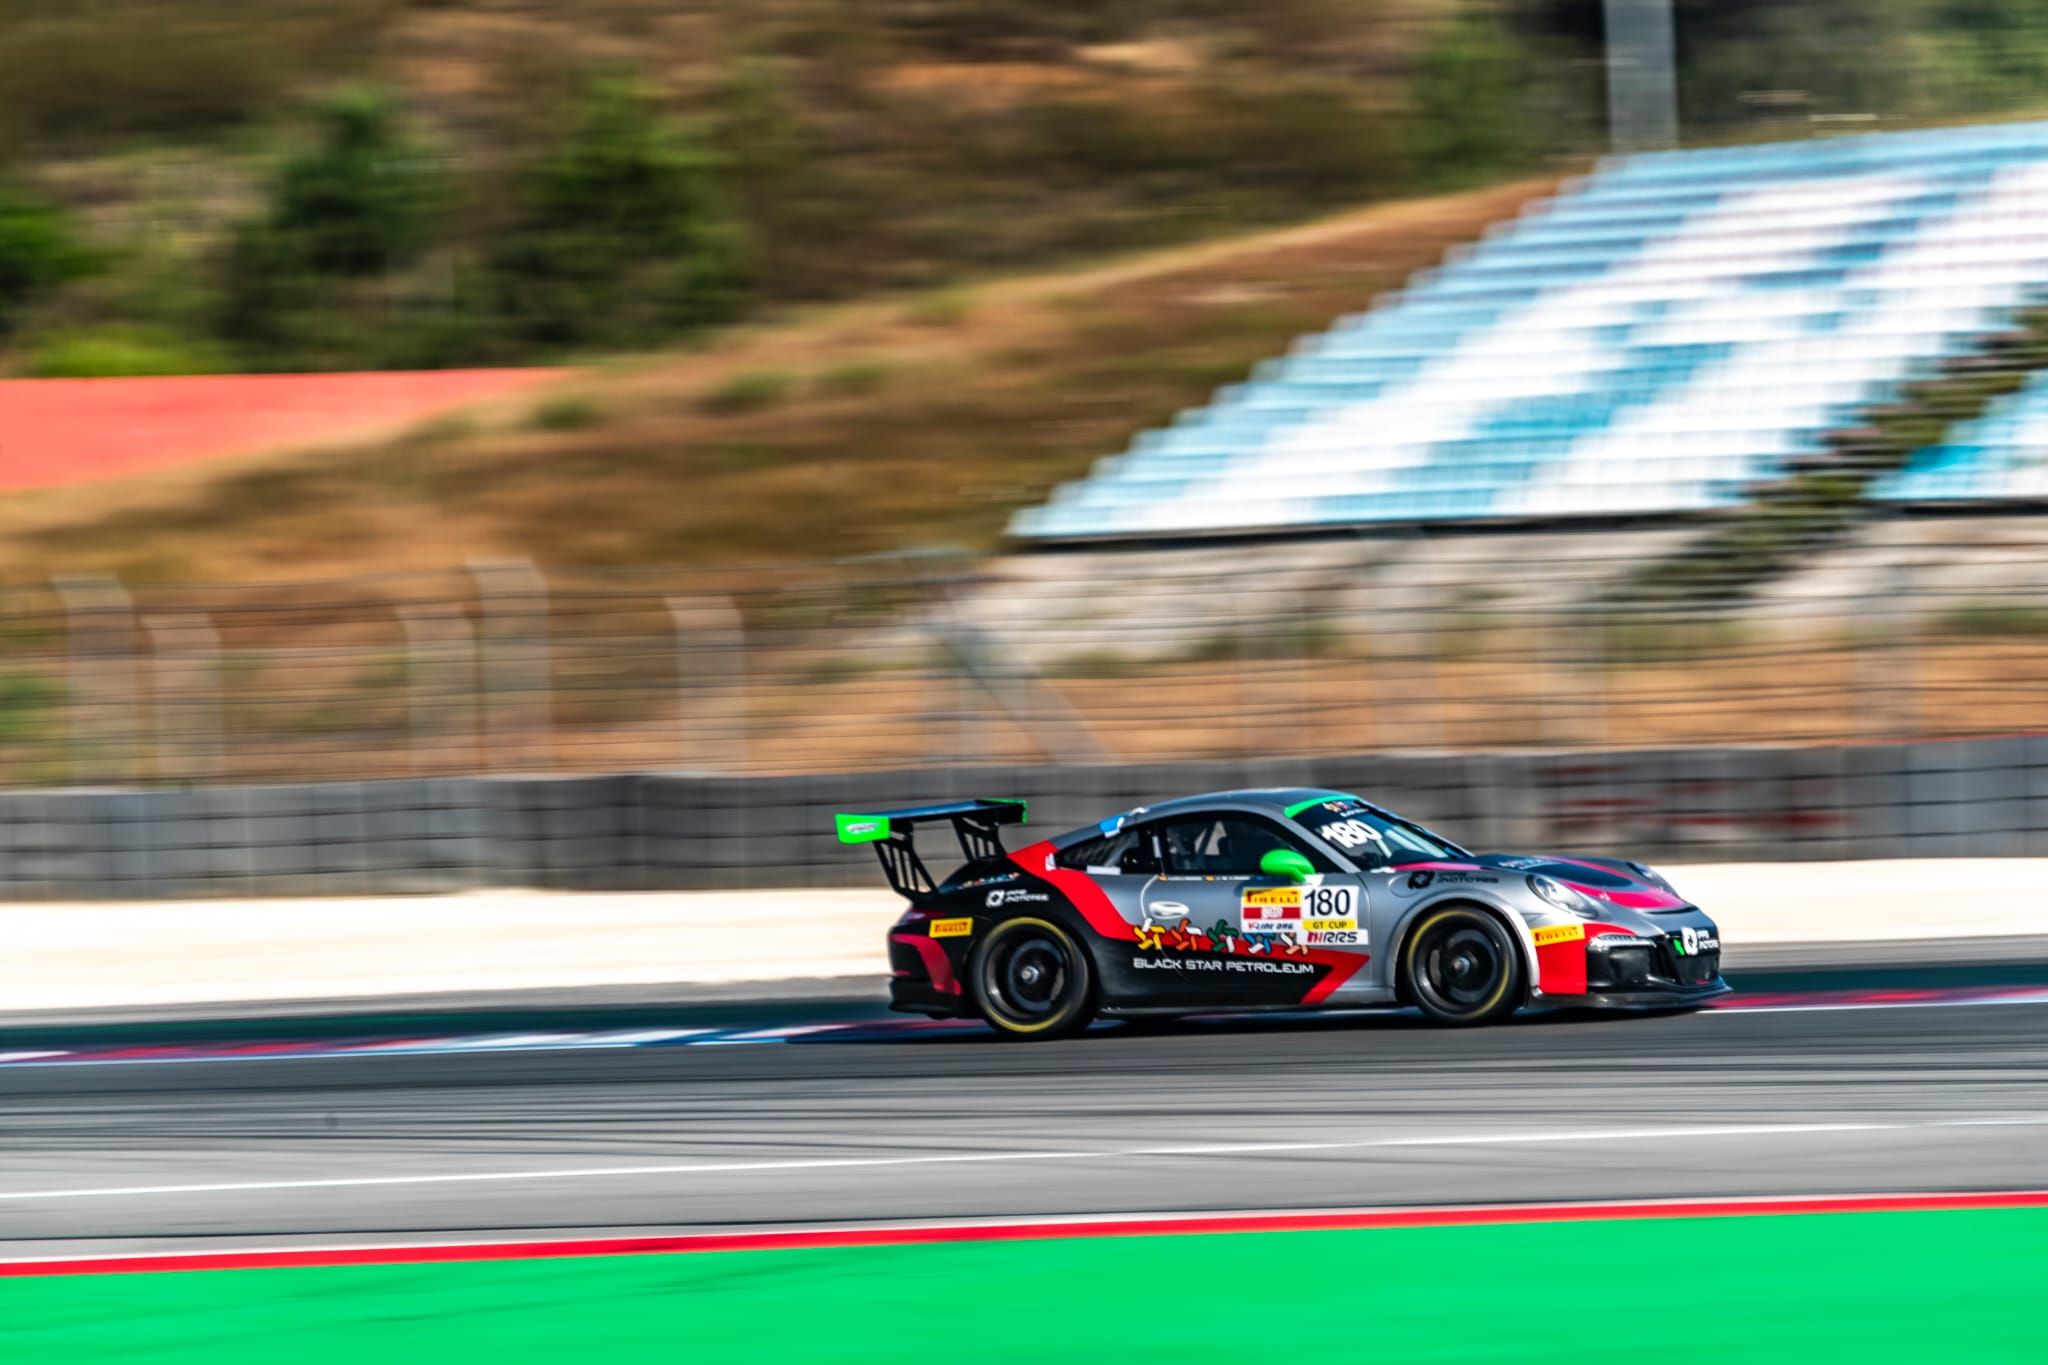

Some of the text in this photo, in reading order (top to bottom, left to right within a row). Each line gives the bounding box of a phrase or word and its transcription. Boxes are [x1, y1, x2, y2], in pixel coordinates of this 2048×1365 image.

[1321, 819, 1382, 848] 180
[1247, 890, 1298, 904] PIRELLI
[1304, 888, 1351, 917] 180
[1312, 921, 1348, 930] GT CUP
[1535, 926, 1577, 942] PIRELLI
[1133, 957, 1314, 974] BLACK STAR PETROLEUM
